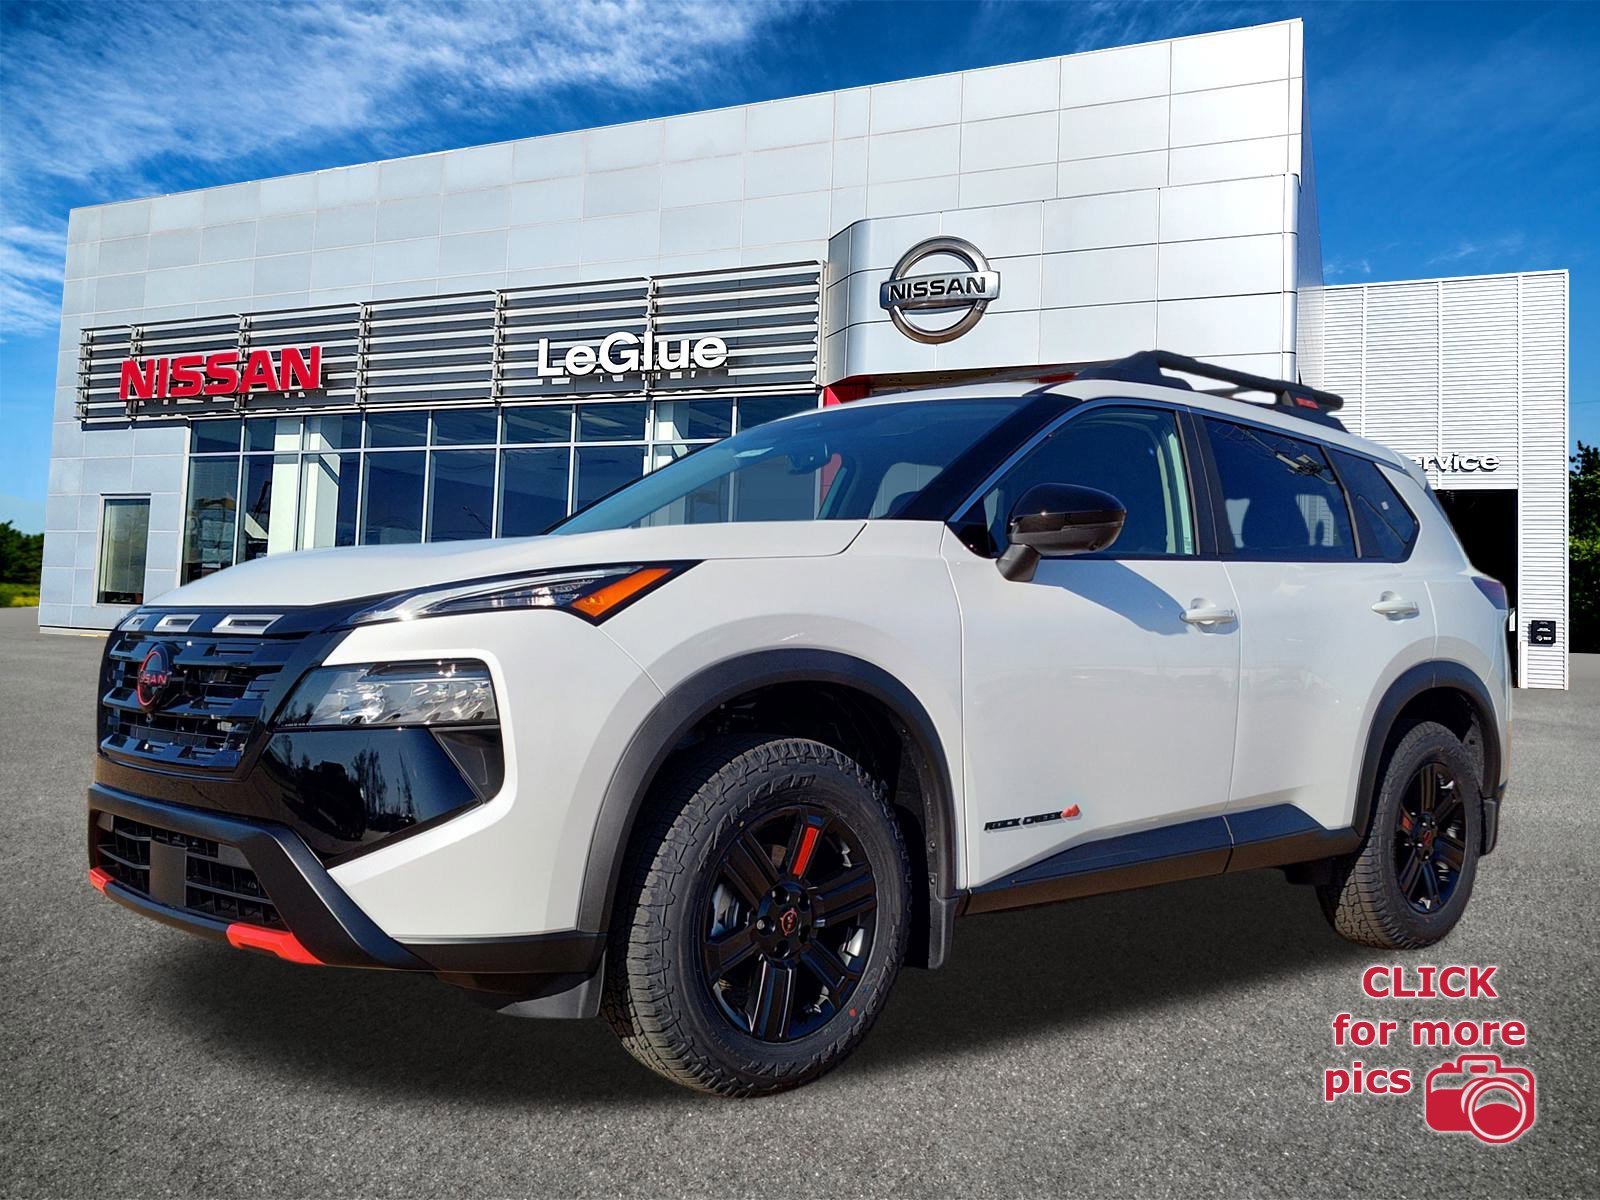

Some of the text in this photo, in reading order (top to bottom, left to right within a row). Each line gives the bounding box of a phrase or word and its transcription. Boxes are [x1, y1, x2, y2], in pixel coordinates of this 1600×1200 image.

[888, 276, 986, 302] NISSAN
[119, 345, 323, 401] NISSAN
[537, 331, 729, 377] LeGlue
